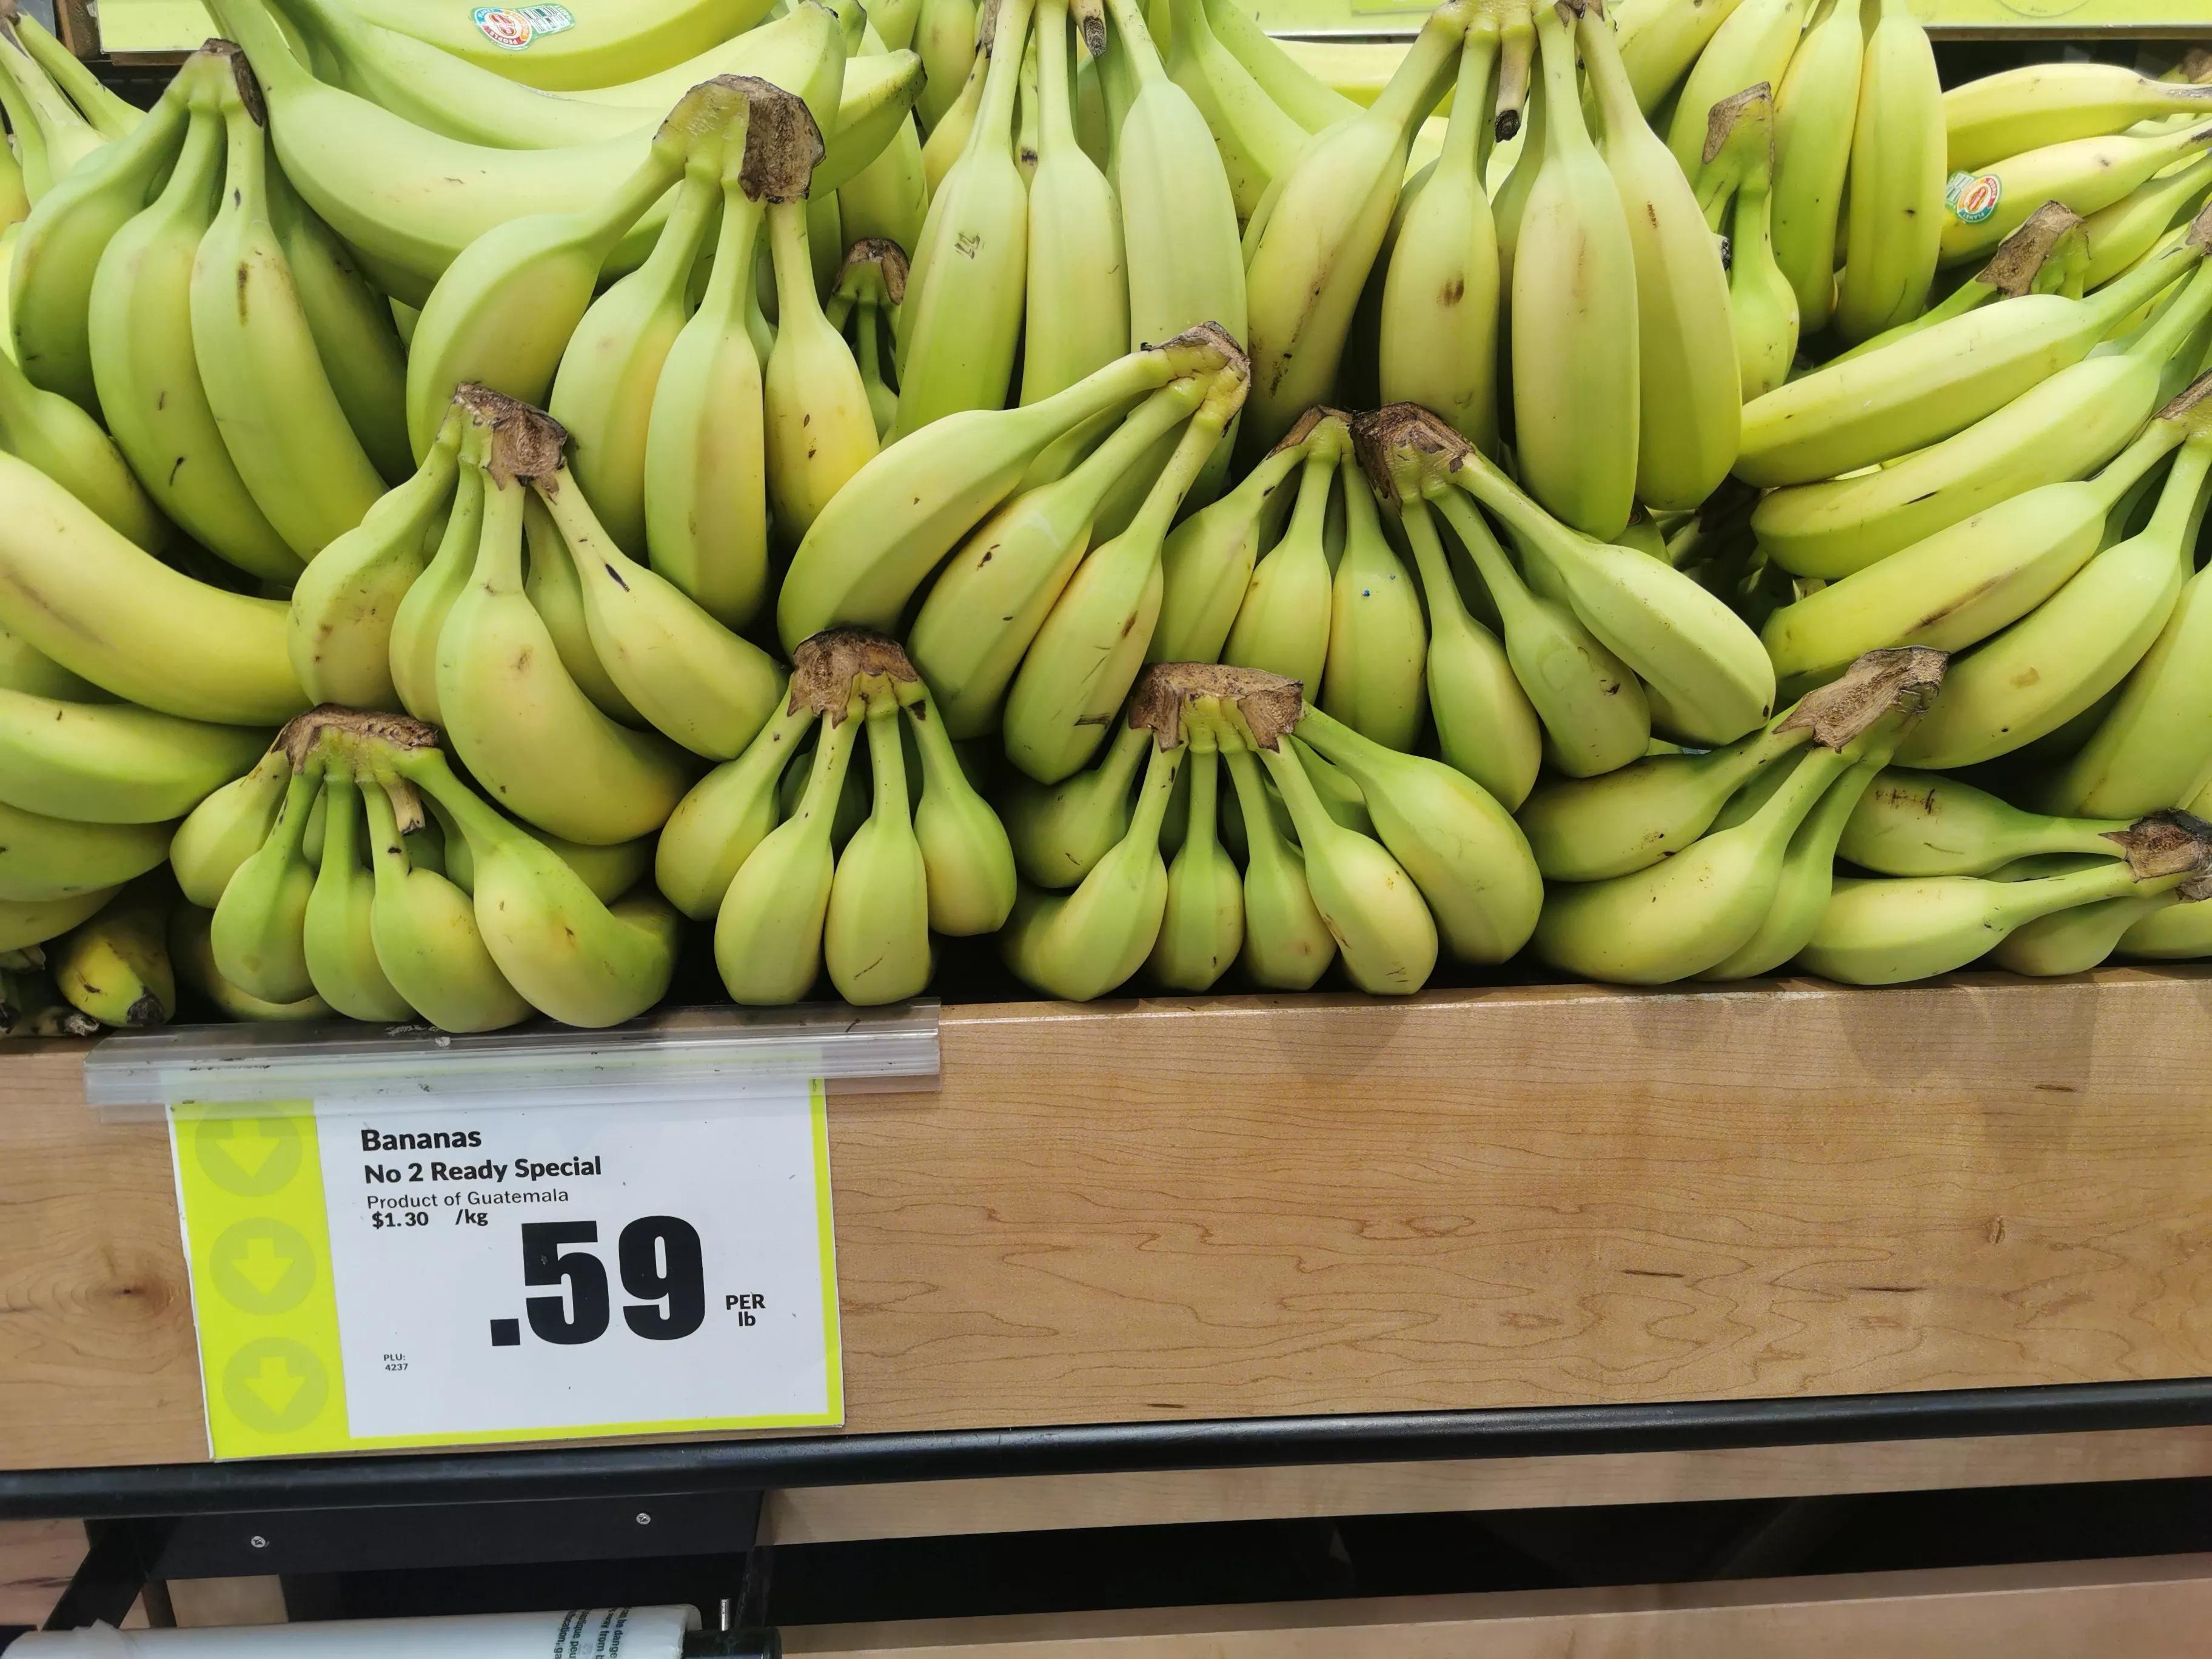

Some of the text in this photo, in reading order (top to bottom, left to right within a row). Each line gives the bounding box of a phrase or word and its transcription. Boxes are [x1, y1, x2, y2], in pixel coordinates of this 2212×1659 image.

[489, 30, 518, 45] PEOPLE
[361, 1129, 481, 1151] Bananas
[364, 1155, 602, 1184] No 2 Ready Special
[367, 1188, 569, 1209] Product of Guatemala
[372, 1208, 488, 1230] $1.30 /kg
[490, 1215, 705, 1346] .59
[726, 1293, 766, 1310] PER
[738, 1311, 756, 1327] lb
[615, 1619, 627, 1627] be
[597, 1631, 609, 1652] from
[609, 1629, 623, 1658] dange
